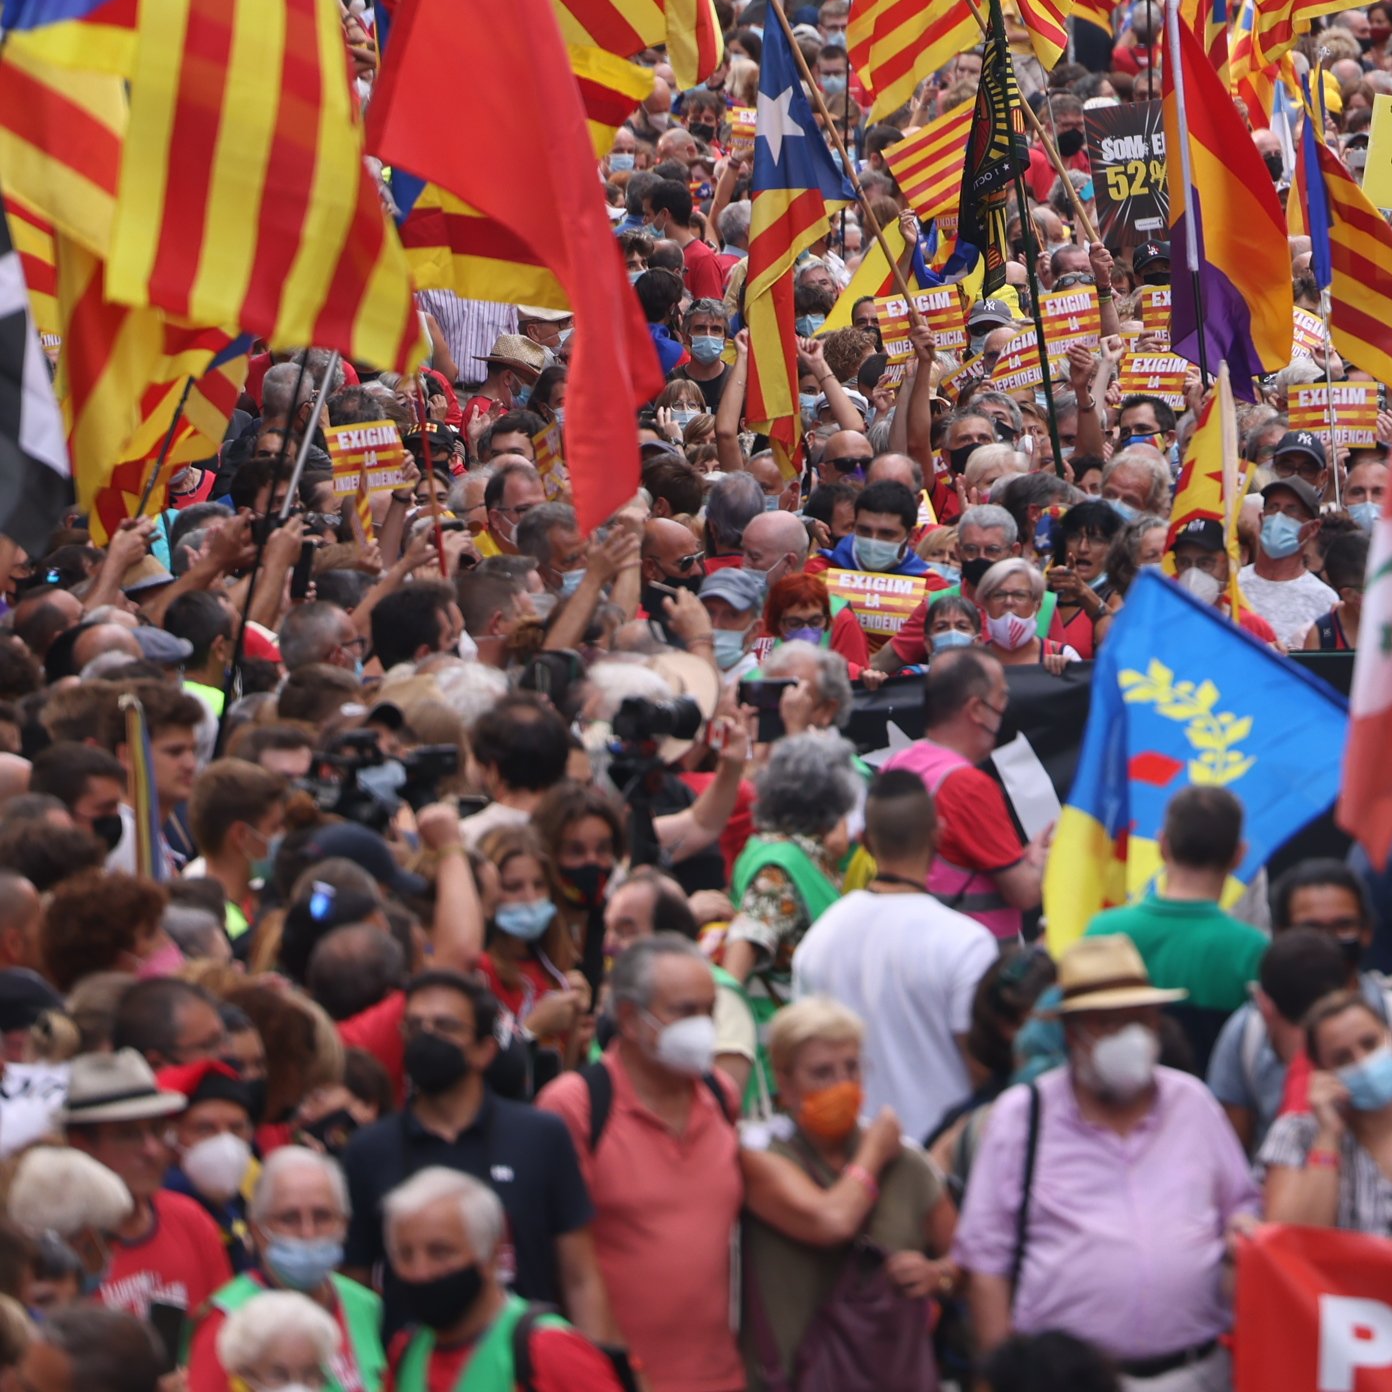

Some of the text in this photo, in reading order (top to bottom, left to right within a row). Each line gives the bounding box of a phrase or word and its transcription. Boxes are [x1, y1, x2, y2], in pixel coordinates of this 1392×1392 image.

[1100, 134, 1142, 162] SOM
[1045, 294, 1092, 317] EXIGIM
[1068, 316, 1080, 331] LA
[1000, 330, 1038, 359] XIGIM
[1008, 356, 1021, 371] LA
[1132, 359, 1189, 373] EXIGIM
[1147, 375, 1160, 389] LA
[1299, 388, 1367, 406] EXIGIM
[337, 426, 398, 450] EXIGIM
[363, 451, 378, 468] LA
[838, 573, 915, 594] EXIGIM
[864, 592, 881, 608] LA
